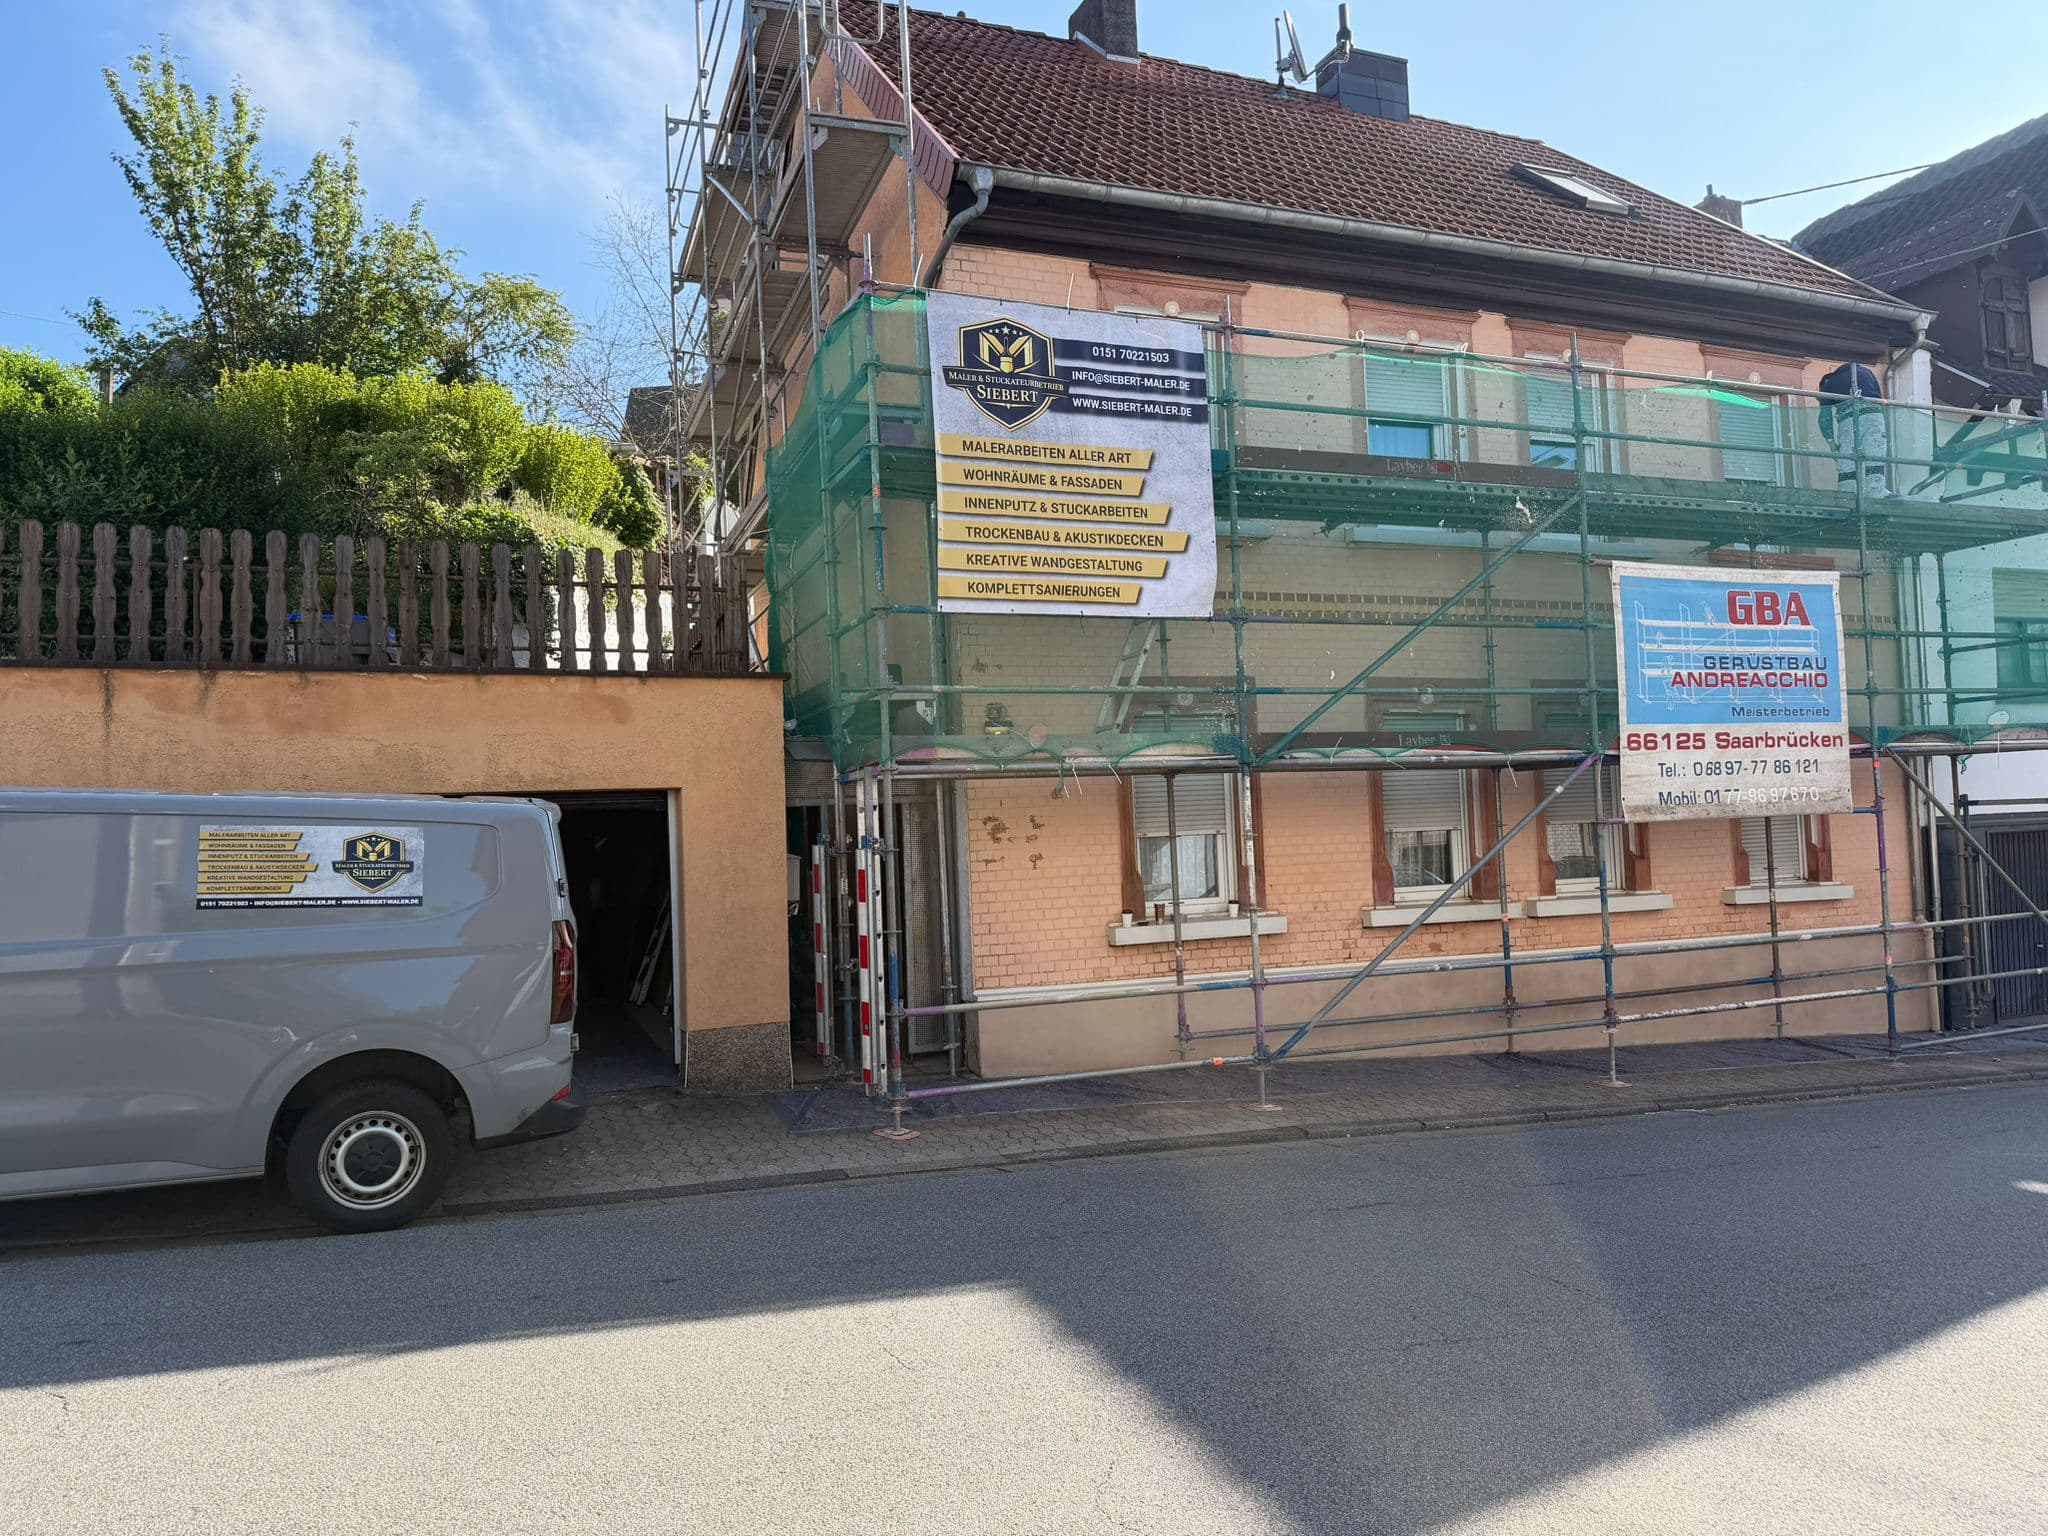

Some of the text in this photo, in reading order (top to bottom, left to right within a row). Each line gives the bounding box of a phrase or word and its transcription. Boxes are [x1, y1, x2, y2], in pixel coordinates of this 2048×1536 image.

[1092, 346, 1170, 363] 0151 70221503
[1072, 370, 1191, 391] INFO@SIEBERT-MALER.DE
[1072, 398, 1192, 417] WWW.SIEBERT-MALER.DE
[962, 440, 1132, 464] MALERARBEITEN ALLER ART
[963, 468, 1123, 490] WOHNRÄUME & FASSADEN
[964, 496, 1148, 519] INNENPUTZ & STUCKARBEITEN
[965, 526, 1164, 547] TROCKENBAU & AKUSTIKDECKEN
[966, 553, 1143, 572] KREATIVE WANDGESTALTUNG
[967, 581, 1121, 598] KOMPLETTSANIERUNGEN
[1727, 590, 1812, 626] GBA
[1703, 652, 1827, 671] GERÜSTBAU
[1671, 672, 1828, 688] ANDREACCHIO
[1731, 706, 1830, 717] Meisterbetrieb
[1626, 731, 1844, 751] 66125 Saarbrücken
[1658, 762, 1686, 777] Tel.:
[1658, 790, 1701, 806] Mobil:
